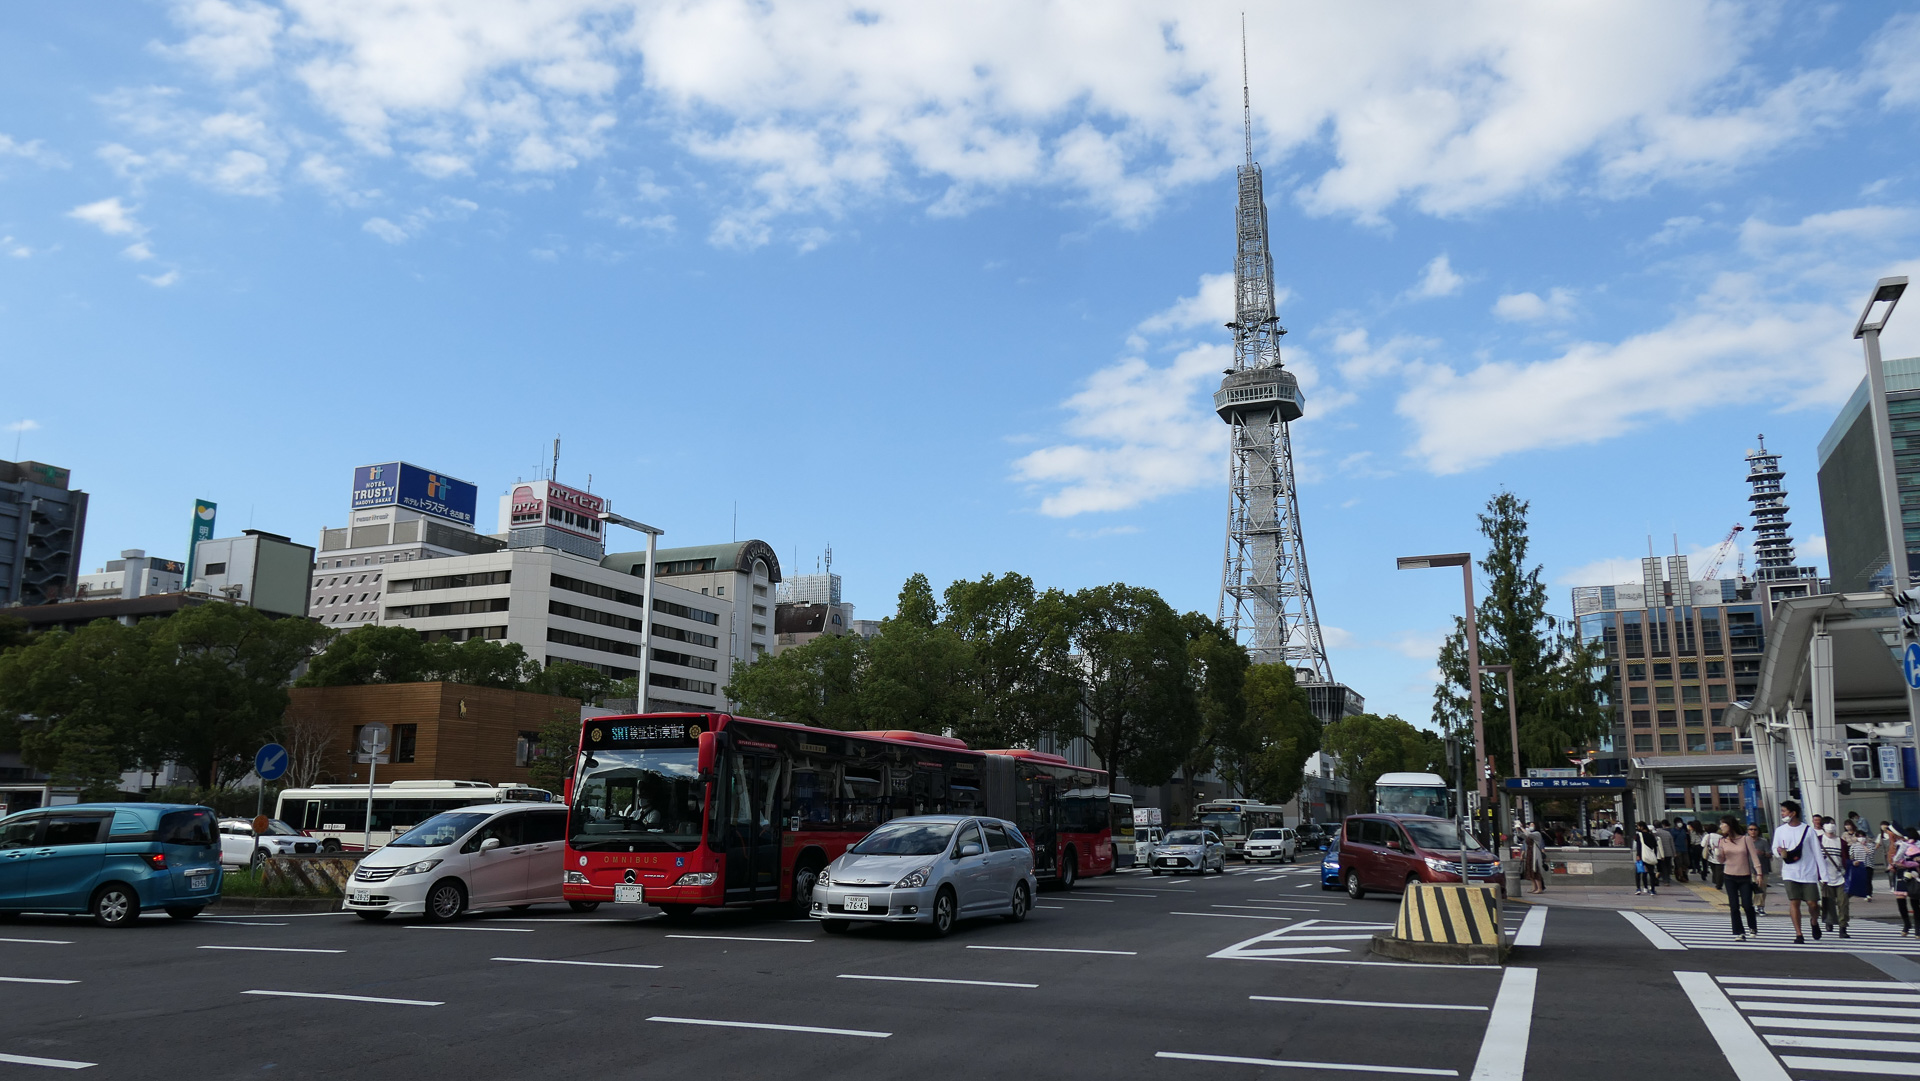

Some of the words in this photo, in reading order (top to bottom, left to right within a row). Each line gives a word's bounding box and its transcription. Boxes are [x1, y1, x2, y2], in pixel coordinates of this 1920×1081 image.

[354, 486, 395, 500] TRUSTY
[513, 500, 541, 512] カワイ
[603, 856, 658, 864] OMNIBUS
